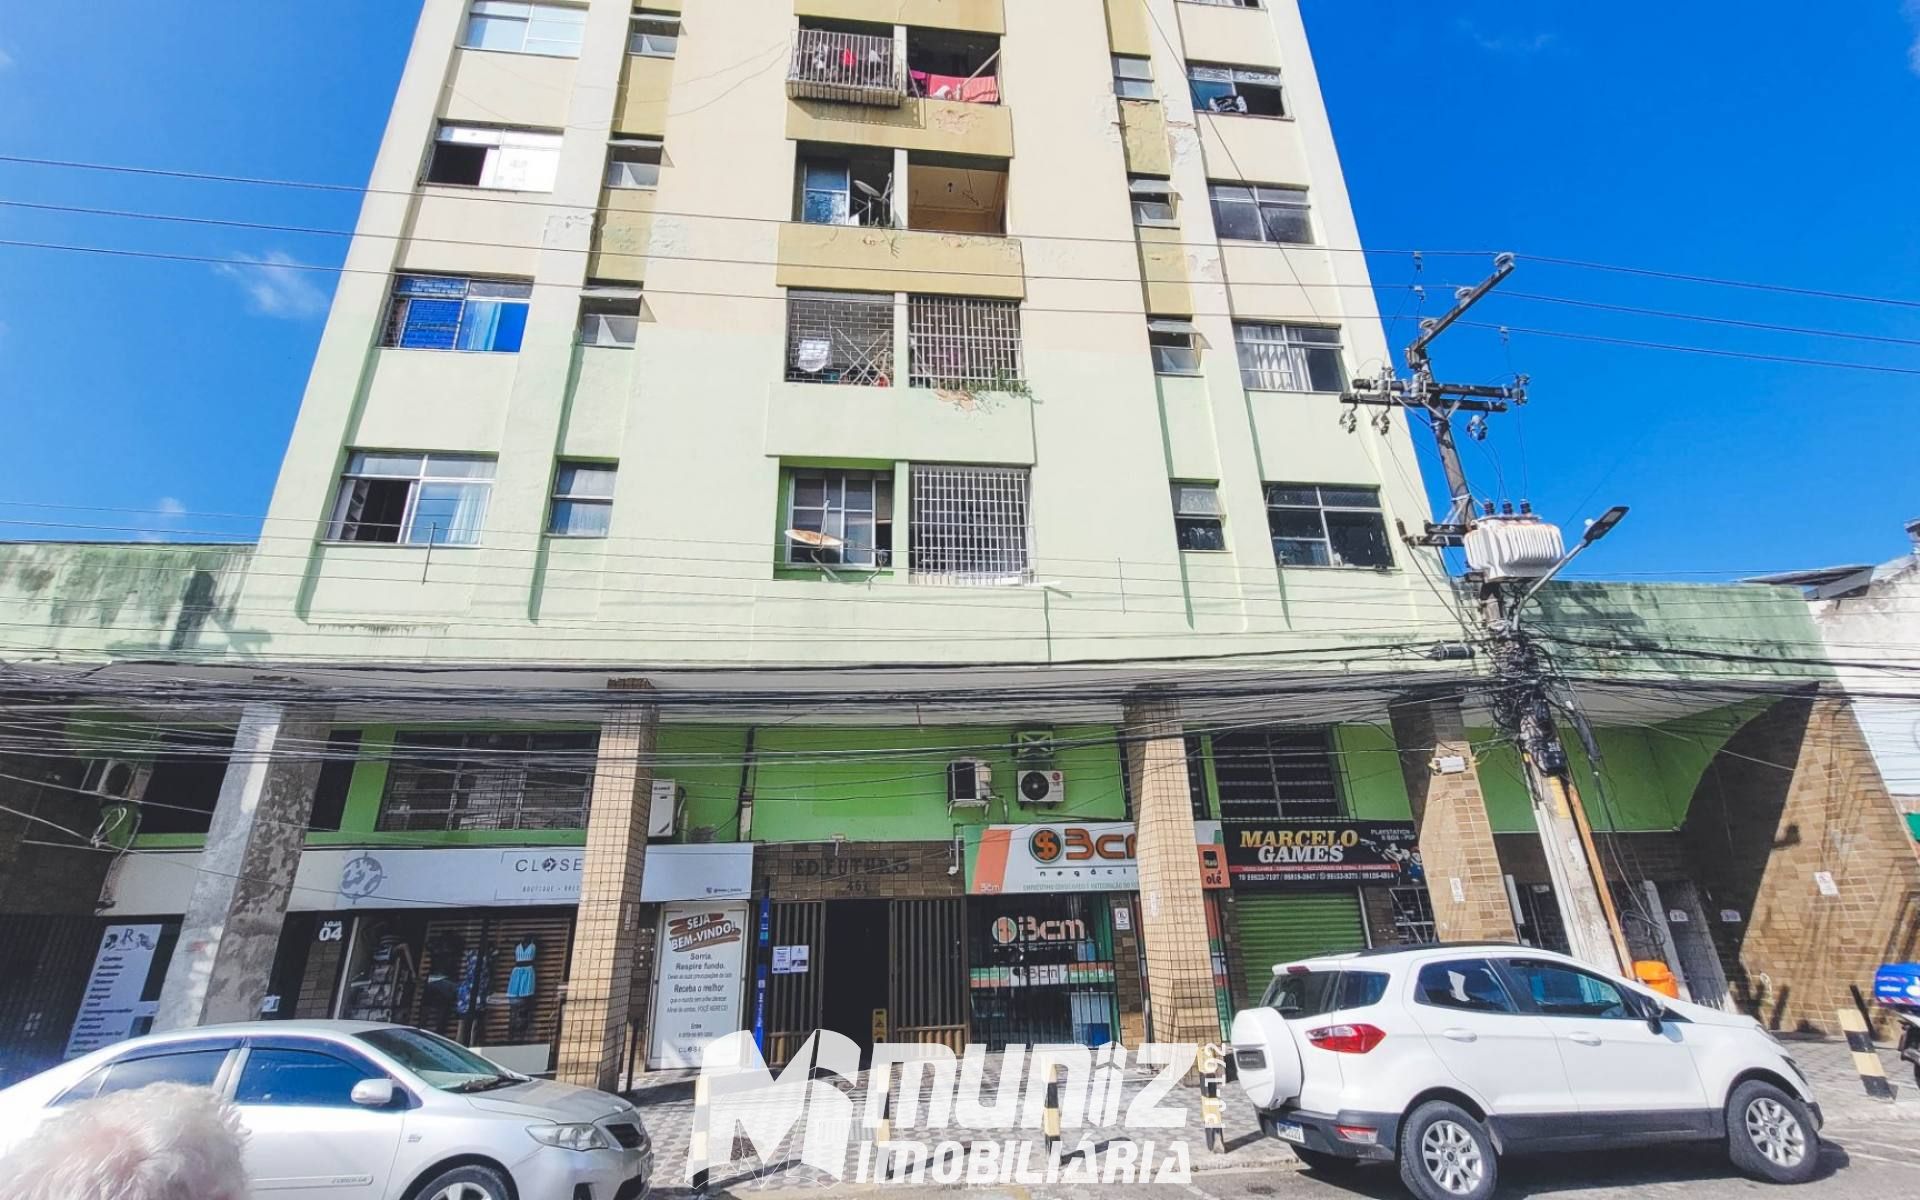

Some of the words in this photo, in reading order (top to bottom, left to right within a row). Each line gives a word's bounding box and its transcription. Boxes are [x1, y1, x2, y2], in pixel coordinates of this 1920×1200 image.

[1240, 829, 1359, 848] MARCELO
[1257, 845, 1344, 864] GAMES
[1206, 870, 1222, 885] olé
[687, 914, 711, 930] SEJA
[319, 927, 343, 941] 04
[671, 921, 737, 950] BEM-VINDO!
[675, 963, 702, 971] Respire
[674, 984, 696, 993] Receba
[703, 983, 724, 992] melhor
